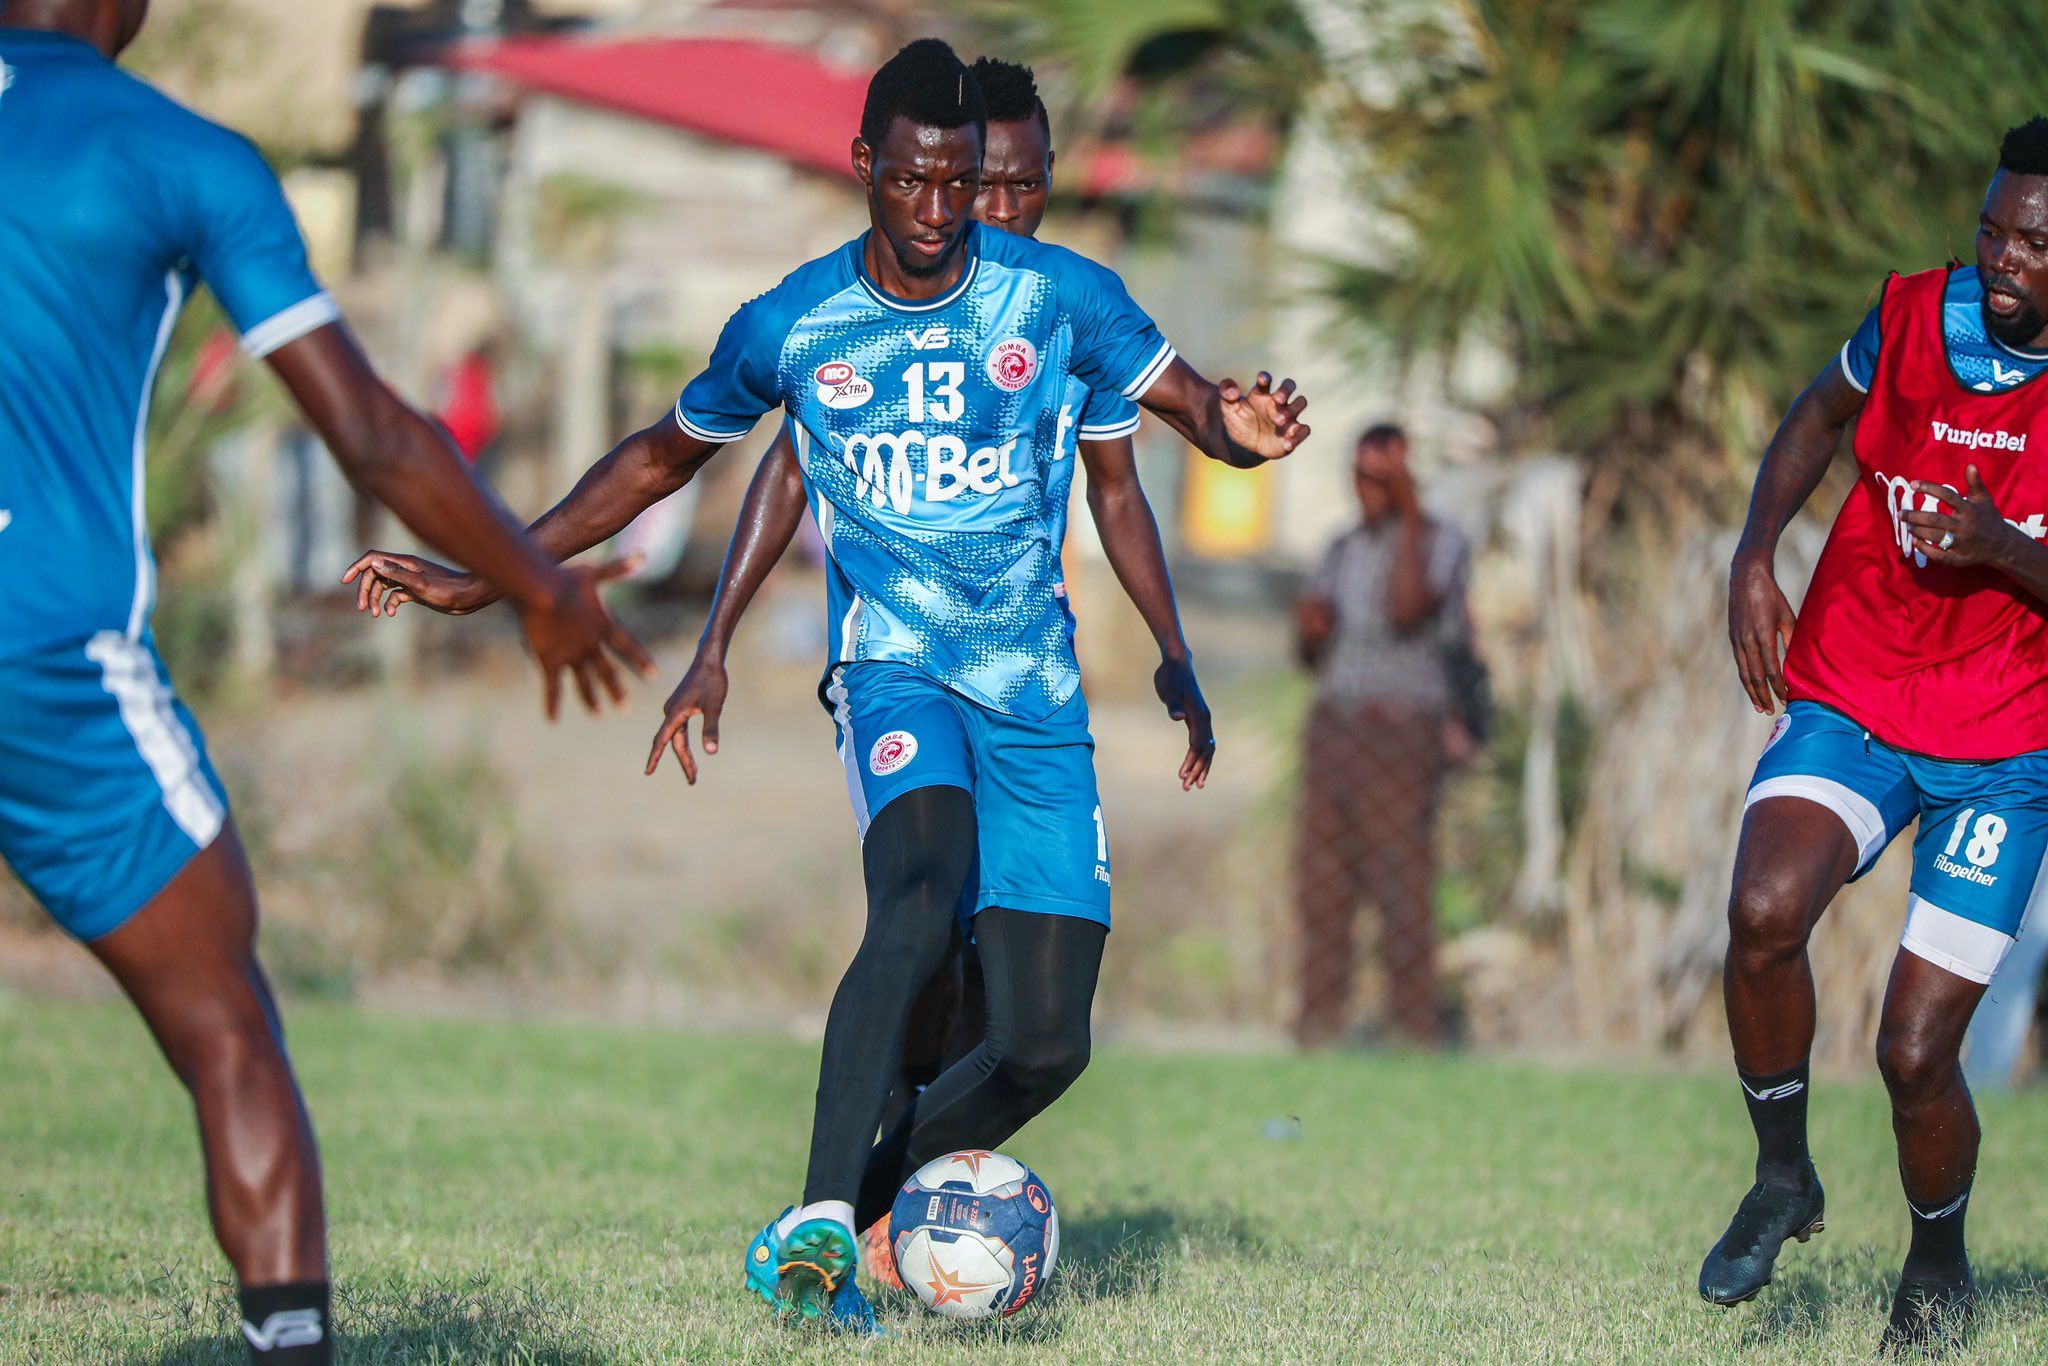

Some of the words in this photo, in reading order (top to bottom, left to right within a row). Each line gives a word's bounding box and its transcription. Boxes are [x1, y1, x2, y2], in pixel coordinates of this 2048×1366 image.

[998, 343, 1026, 354] SIMBA
[829, 379, 867, 403] XTRA
[902, 362, 965, 422] 13
[1932, 421, 2027, 452] VunjaBei
[829, 430, 1019, 515] M-Bet
[877, 734, 903, 746] SIMBA
[1945, 808, 2008, 868] 18
[972, 1199, 980, 1207] 5
[969, 1207, 979, 1226] SIZE
